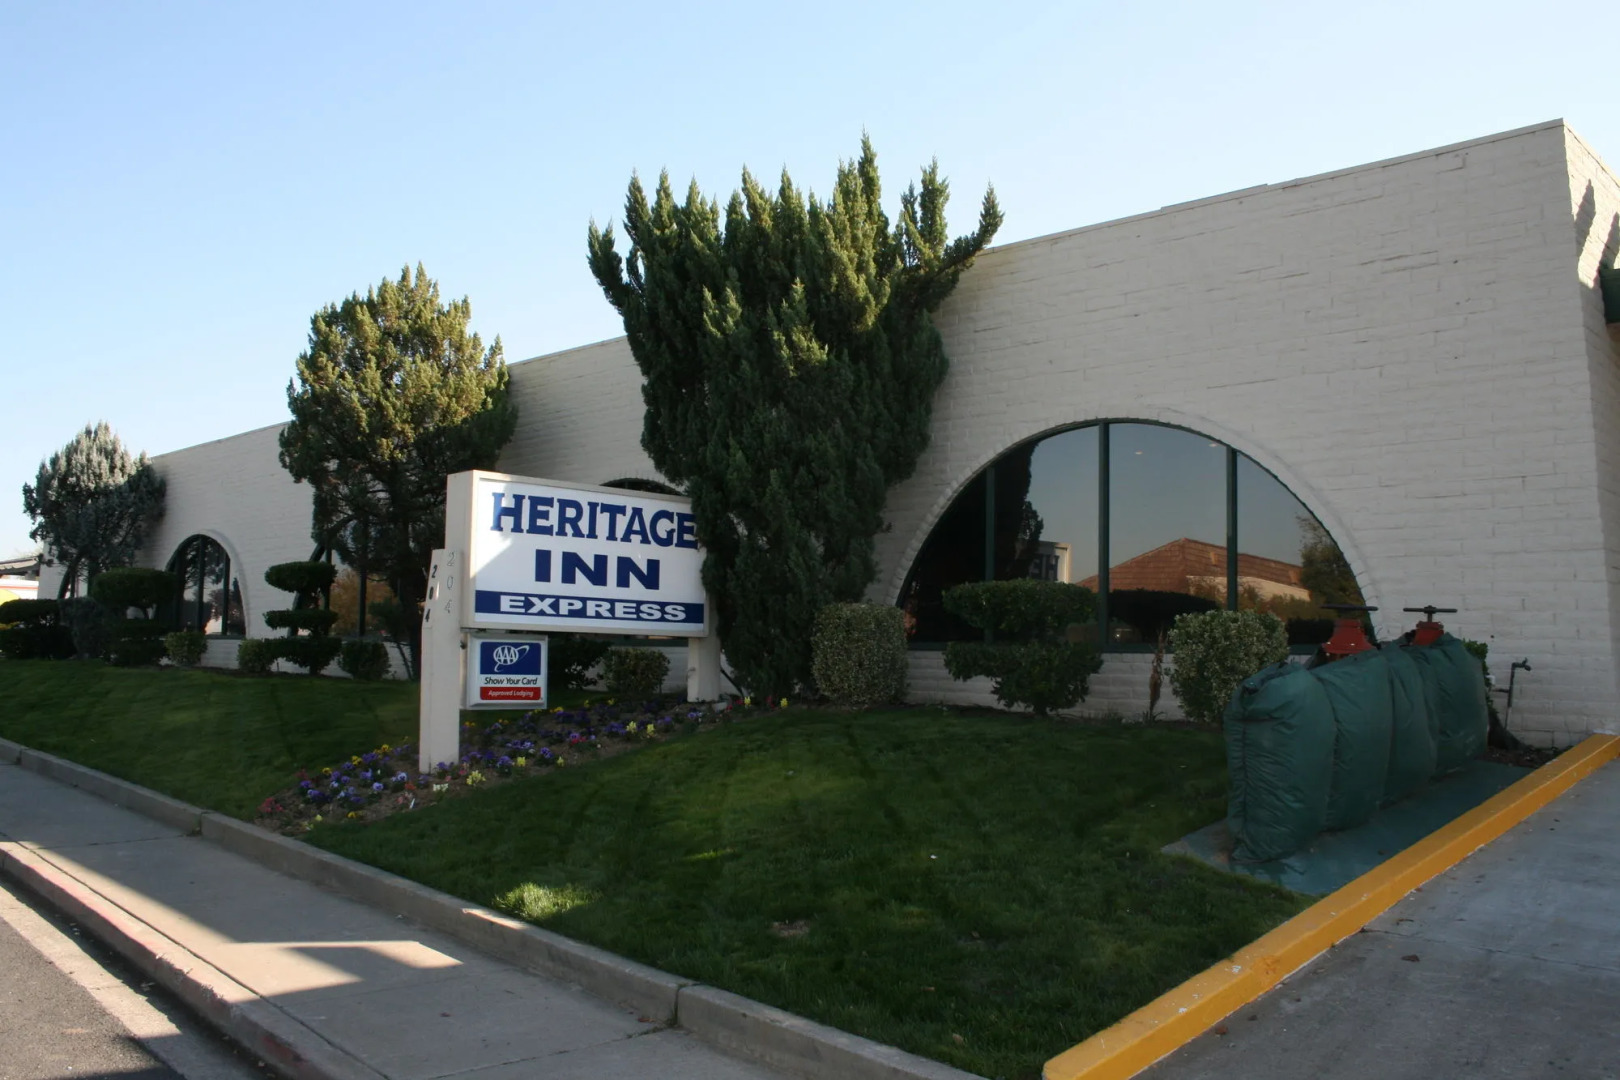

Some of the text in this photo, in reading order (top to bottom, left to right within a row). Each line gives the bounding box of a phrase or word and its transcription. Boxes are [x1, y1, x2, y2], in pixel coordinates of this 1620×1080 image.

[490, 492, 699, 549] HERITAGE
[535, 549, 660, 590] INN
[425, 564, 438, 622] 204
[500, 595, 687, 621] EXPRESS
[495, 646, 517, 664] AAA
[484, 676, 538, 685] Show Your Card
[513, 690, 534, 698] Lodging
